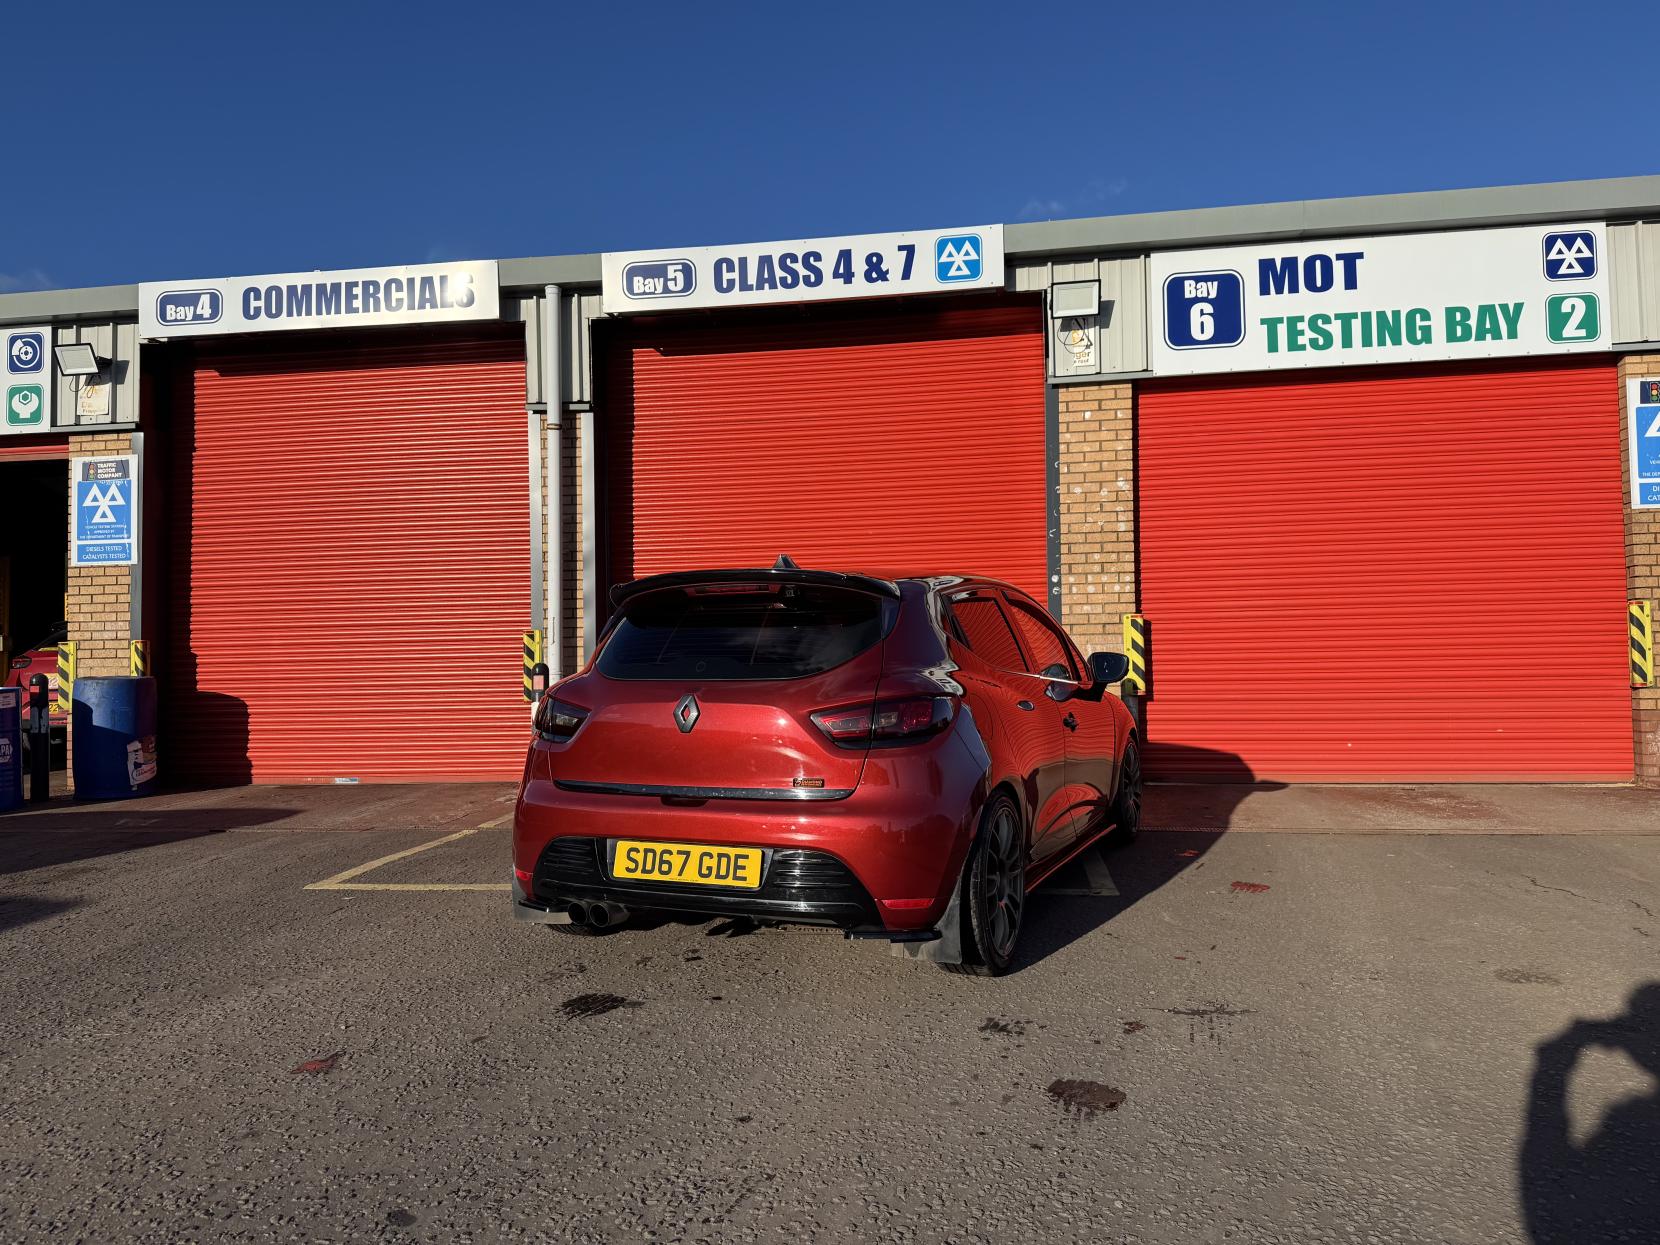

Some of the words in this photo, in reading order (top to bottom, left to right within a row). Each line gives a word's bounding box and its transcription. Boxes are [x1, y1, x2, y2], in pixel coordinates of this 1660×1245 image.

[633, 276, 664, 295] Bay
[667, 264, 684, 292] 5
[713, 253, 824, 294] CLASS
[832, 249, 855, 285] 4
[863, 252, 890, 283] &
[897, 244, 917, 281] 7
[1184, 279, 1218, 299] Bay
[1257, 252, 1364, 296] MOT
[166, 304, 194, 322] Bay
[196, 294, 212, 319] 4
[242, 274, 475, 321] COMMERCIALS
[1561, 297, 1587, 338] 2
[1190, 302, 1215, 341] 6
[1260, 308, 1433, 353] TESTING
[1444, 302, 1525, 343] BAY
[625, 847, 692, 877] SD67
[697, 851, 750, 882] GDE
